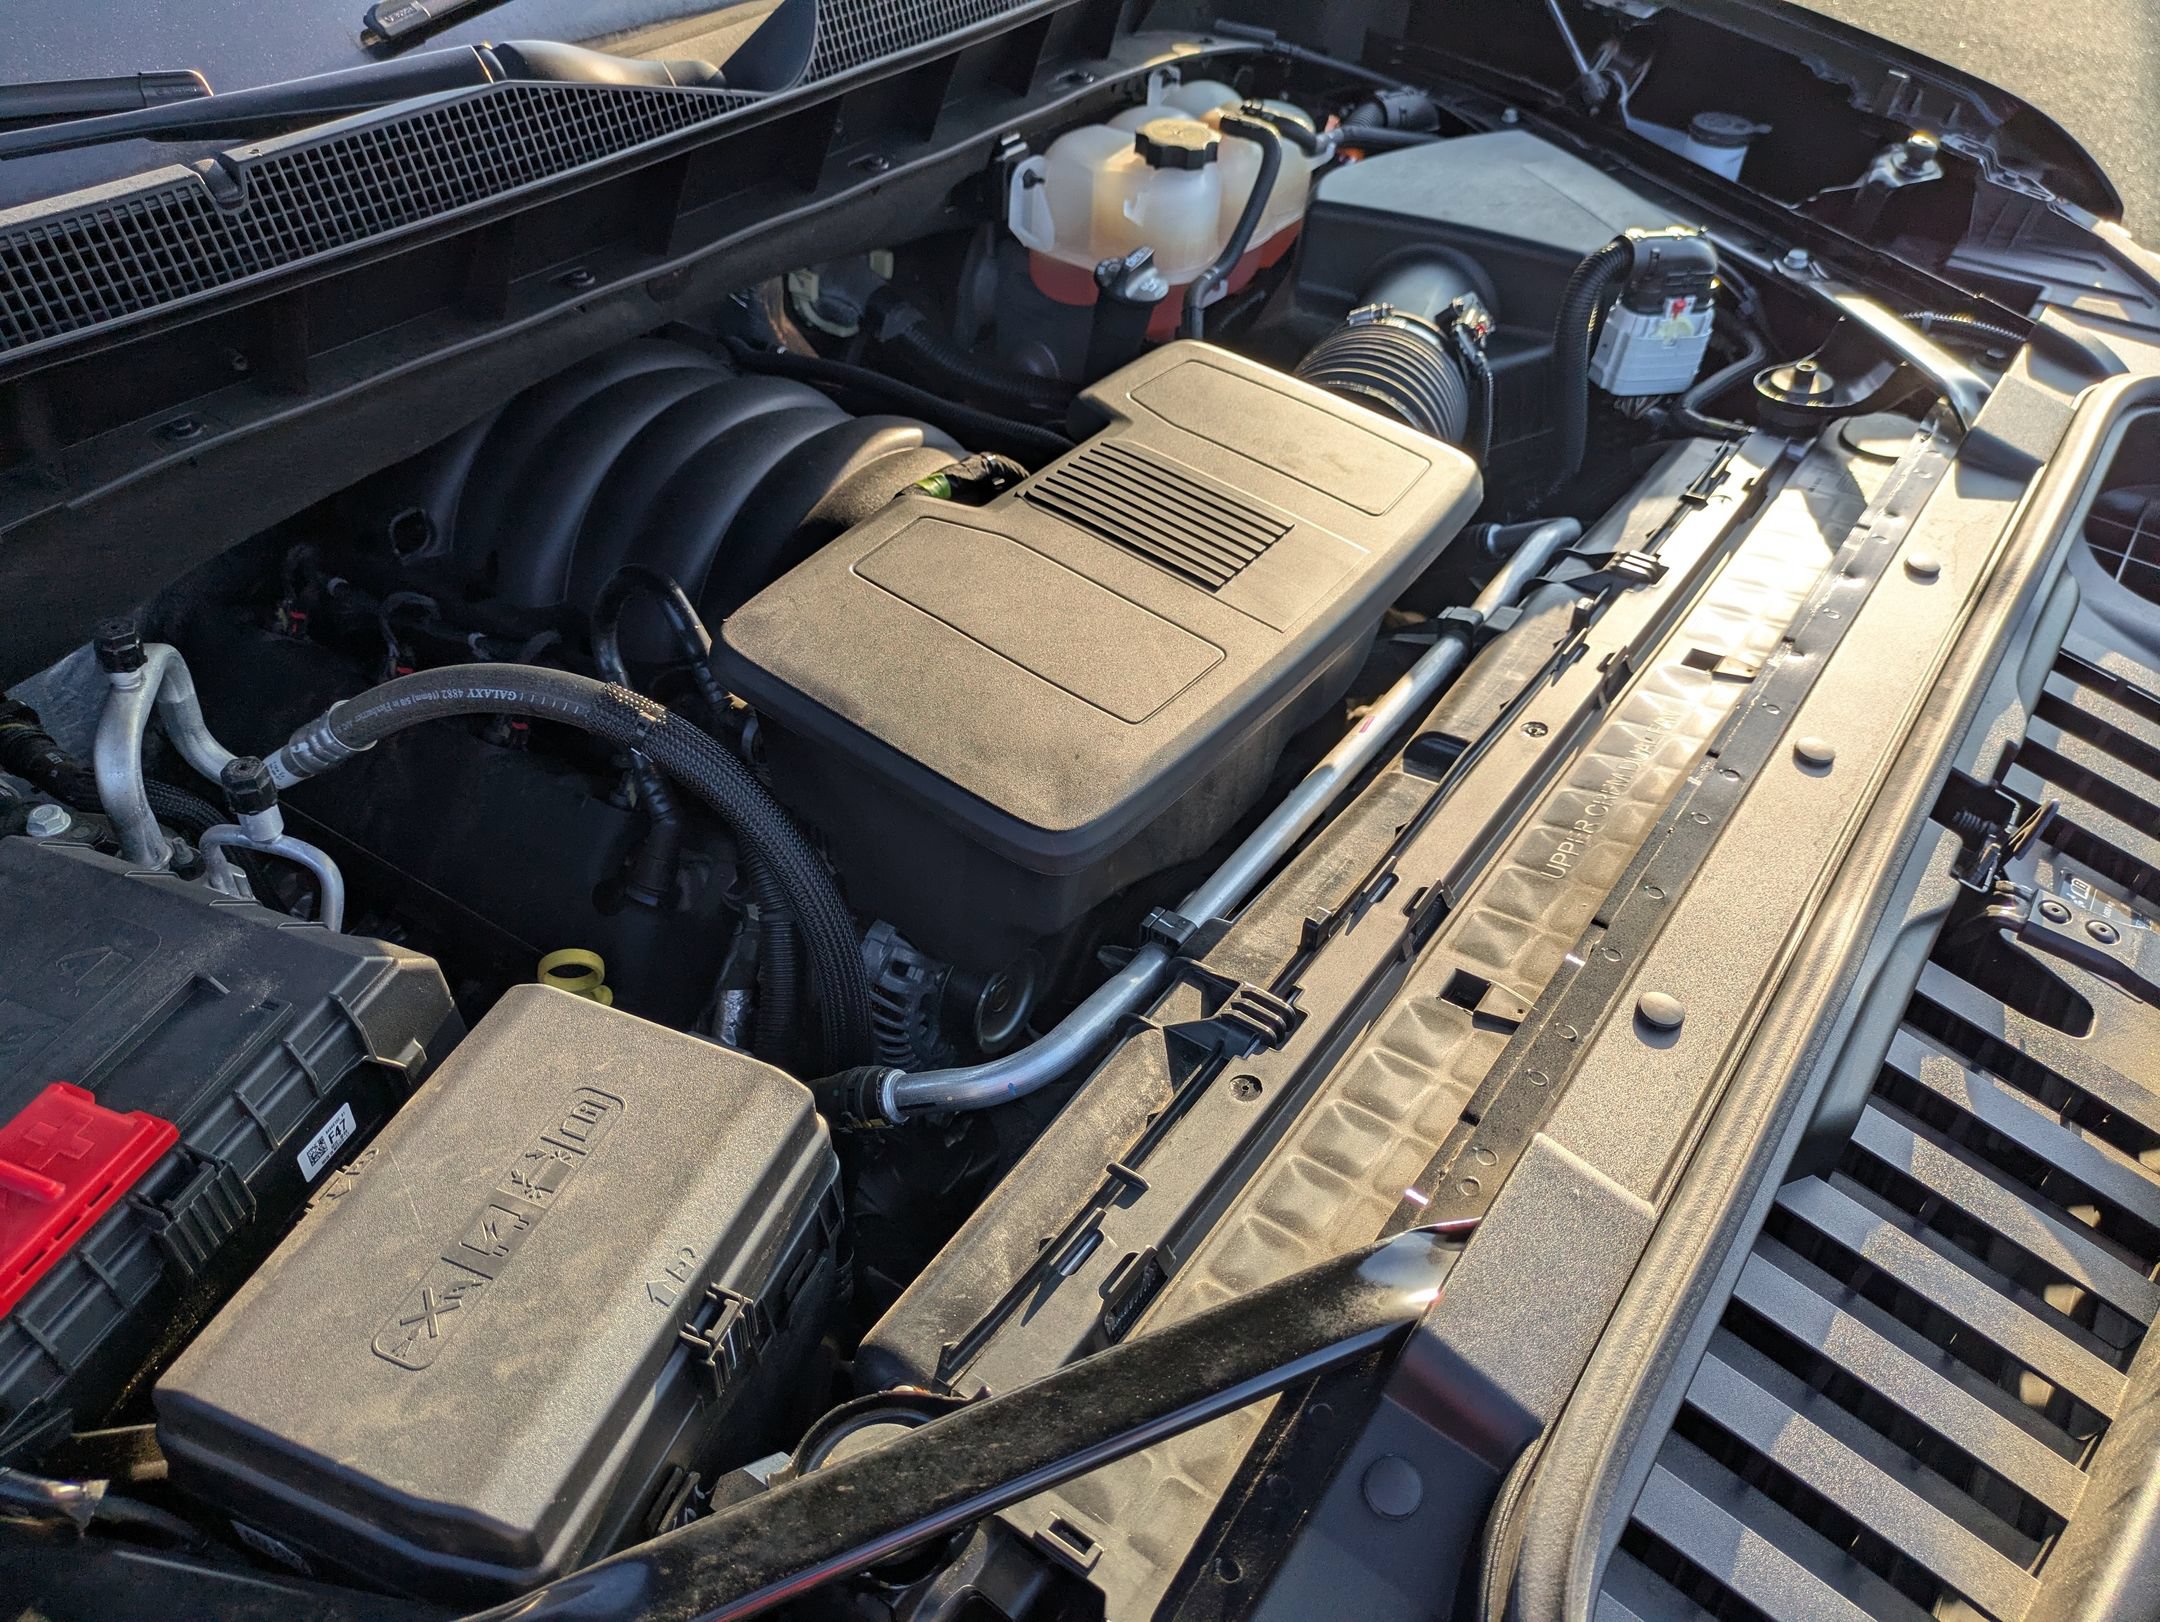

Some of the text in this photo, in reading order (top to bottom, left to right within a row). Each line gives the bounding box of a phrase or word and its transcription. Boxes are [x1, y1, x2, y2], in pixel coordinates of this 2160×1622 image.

[442, 688, 464, 700] 4882
[466, 688, 517, 700] GALAXY
[1540, 818, 1600, 879] UPPER
[1616, 736, 1658, 771] DUAL
[1647, 710, 1681, 735] FAN
[327, 1118, 347, 1145] F47
